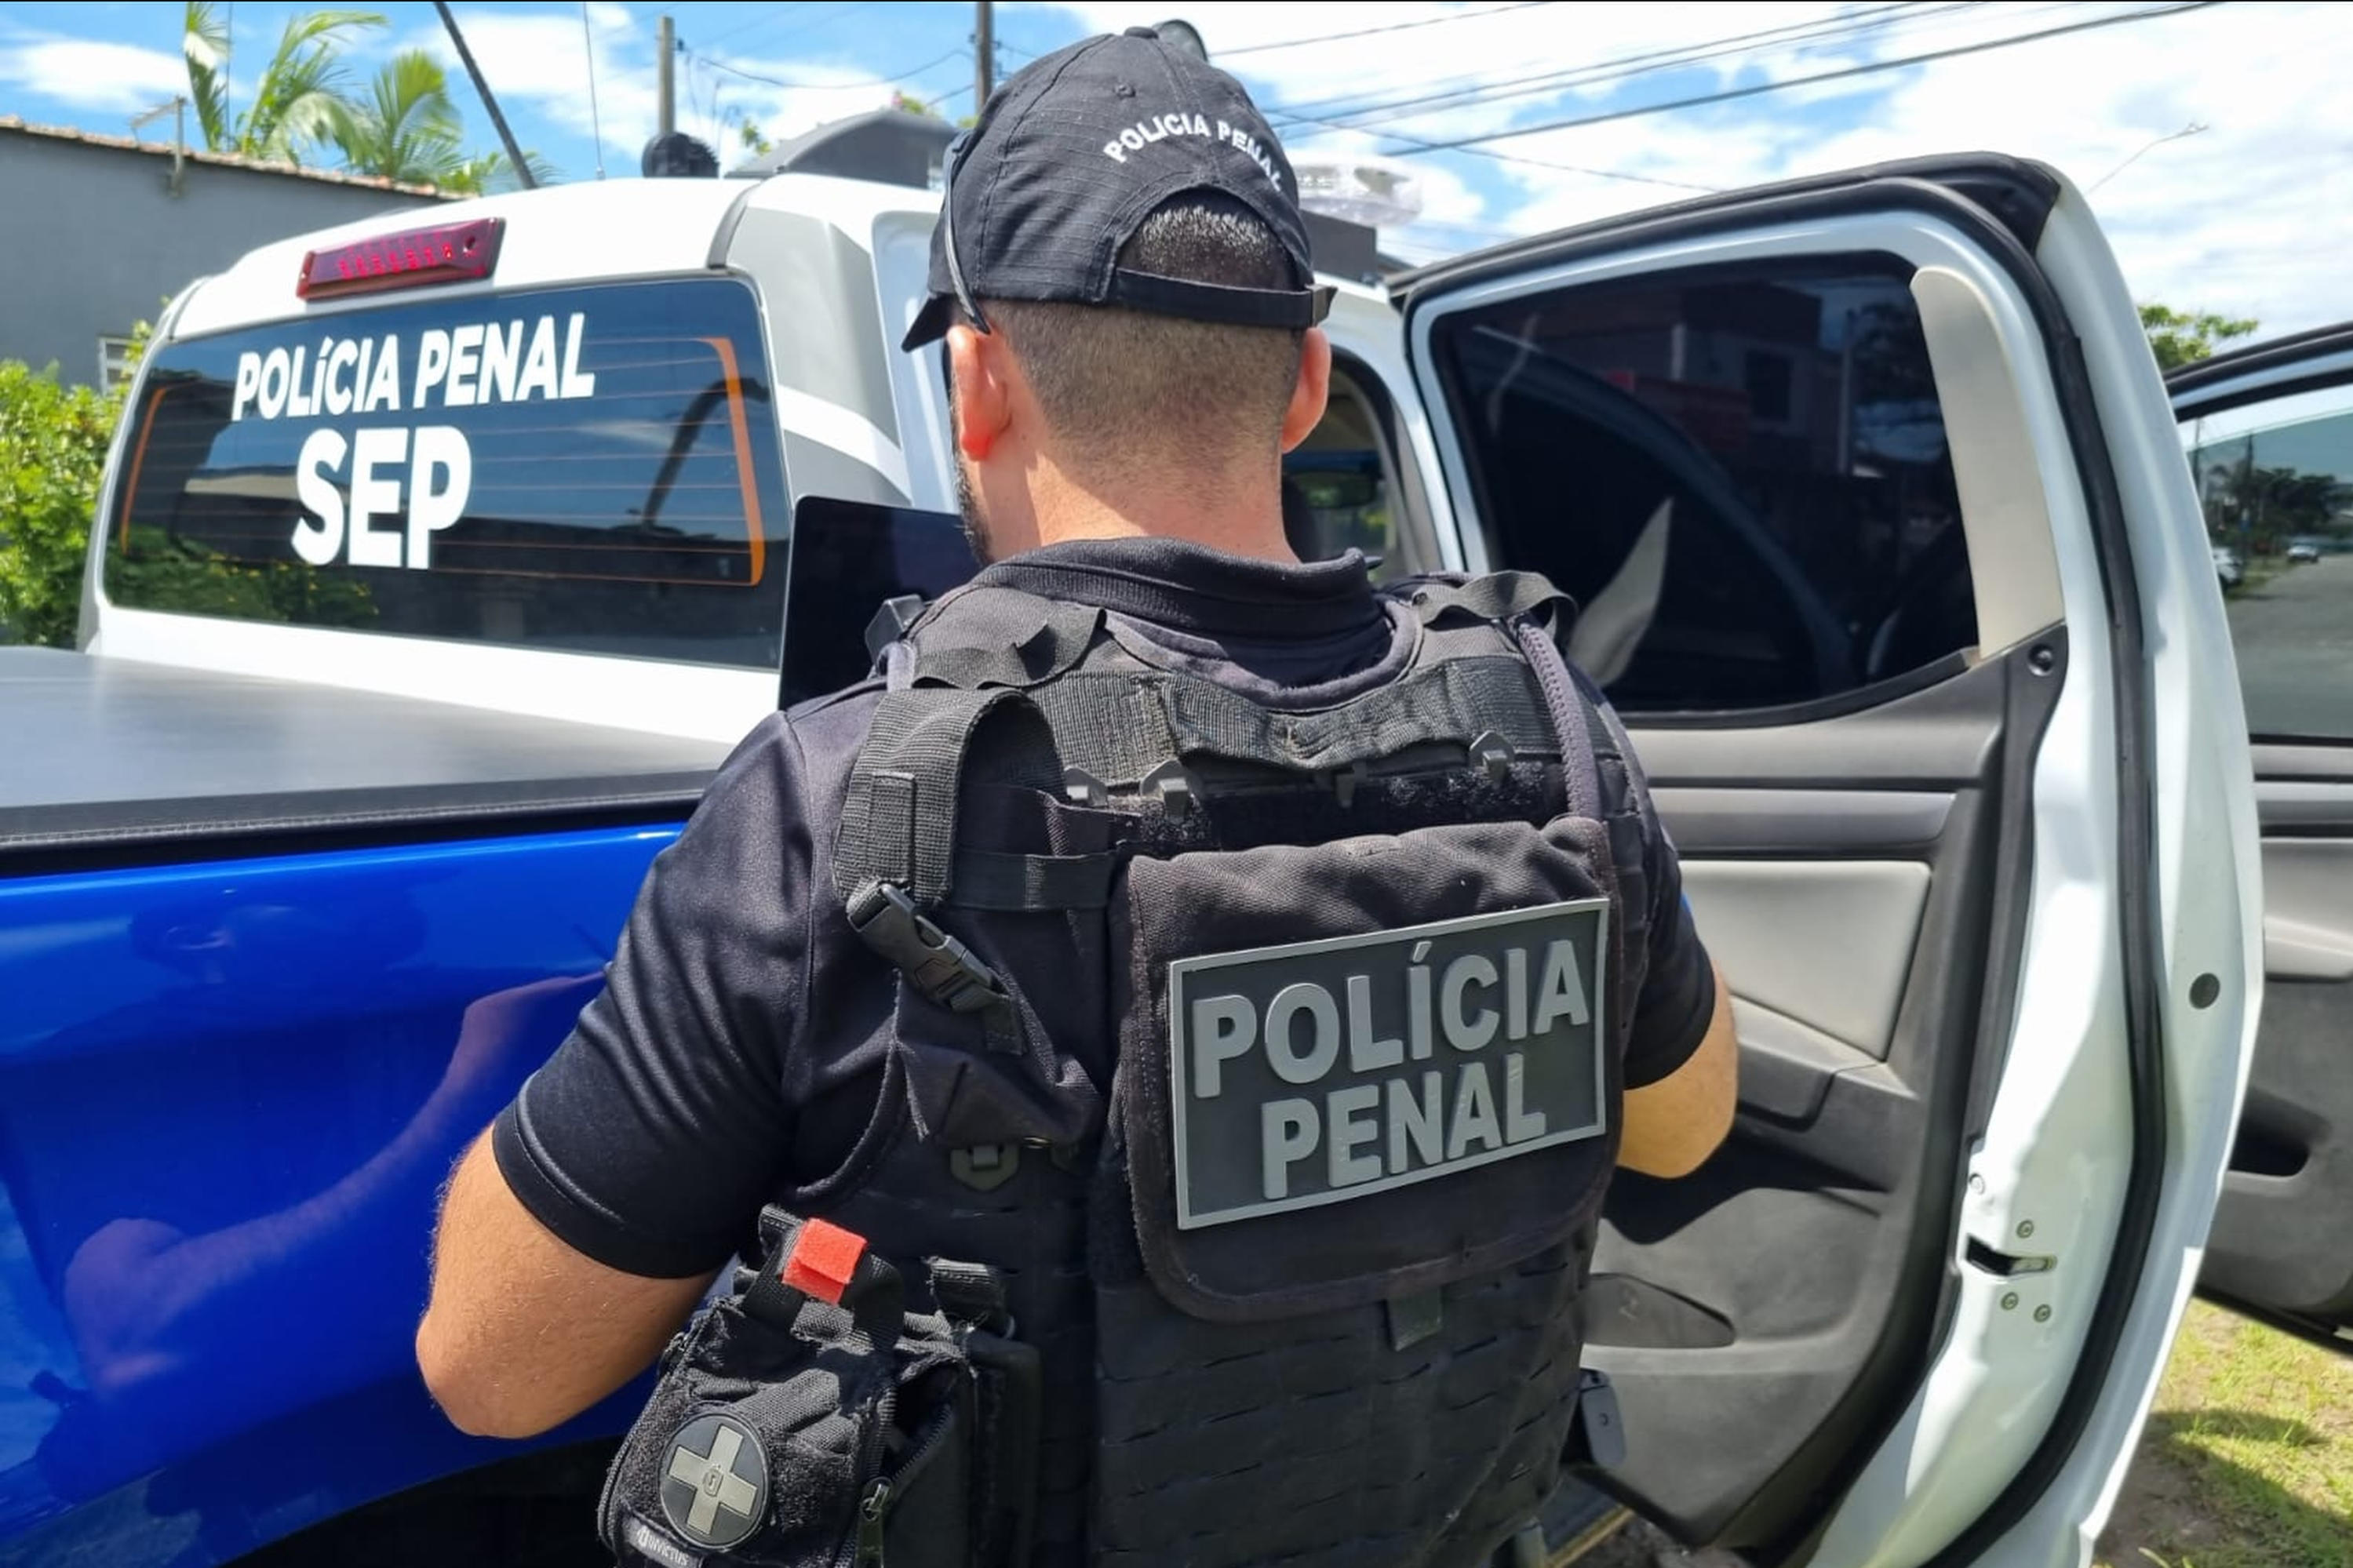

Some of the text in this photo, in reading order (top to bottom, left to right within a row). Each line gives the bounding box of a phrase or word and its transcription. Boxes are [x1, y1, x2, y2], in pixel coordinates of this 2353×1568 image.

[1217, 119, 1280, 192] PENAL
[413, 312, 595, 409] PENAL
[291, 425, 472, 570] SEP
[1193, 940, 1589, 1098] POLÍCIA
[1262, 1053, 1546, 1200] PENAL
